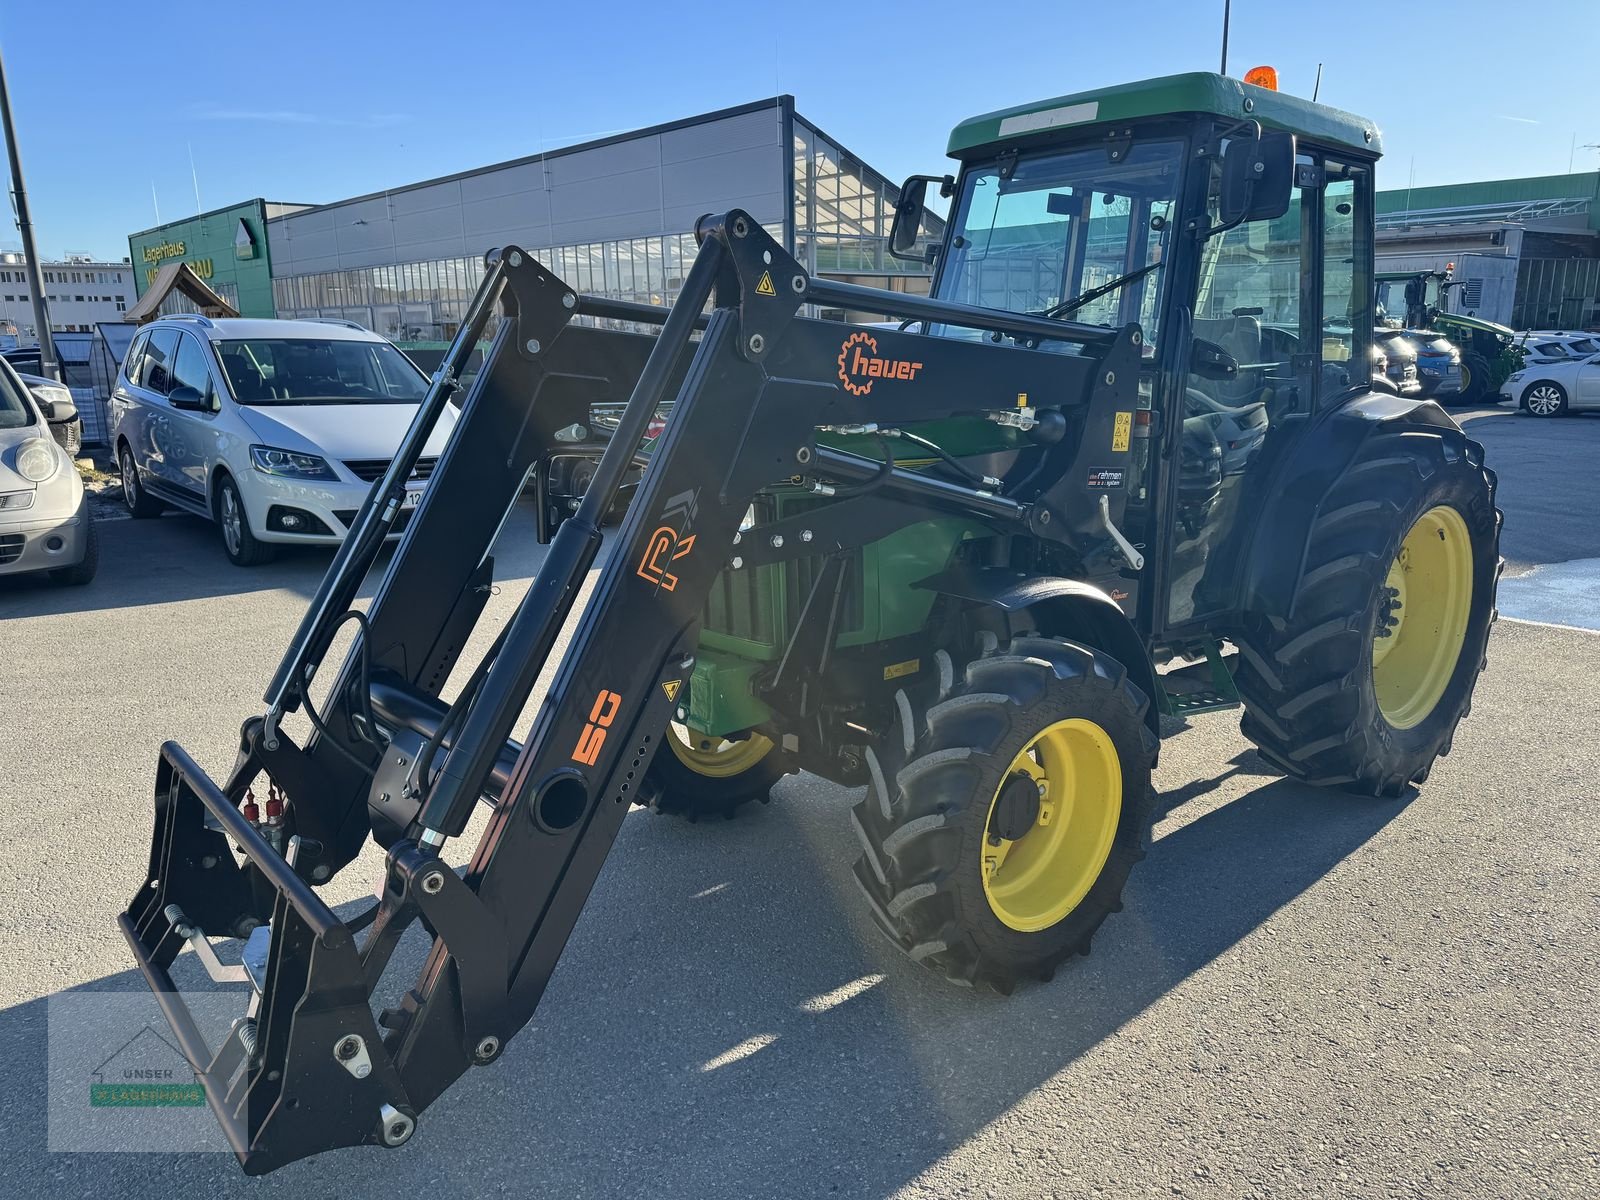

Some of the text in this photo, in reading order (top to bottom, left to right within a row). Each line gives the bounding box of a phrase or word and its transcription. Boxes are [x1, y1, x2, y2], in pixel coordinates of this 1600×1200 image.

[142, 240, 185, 265] Lagerhaus
[851, 346, 923, 380] hauer
[571, 689, 622, 766] 50
